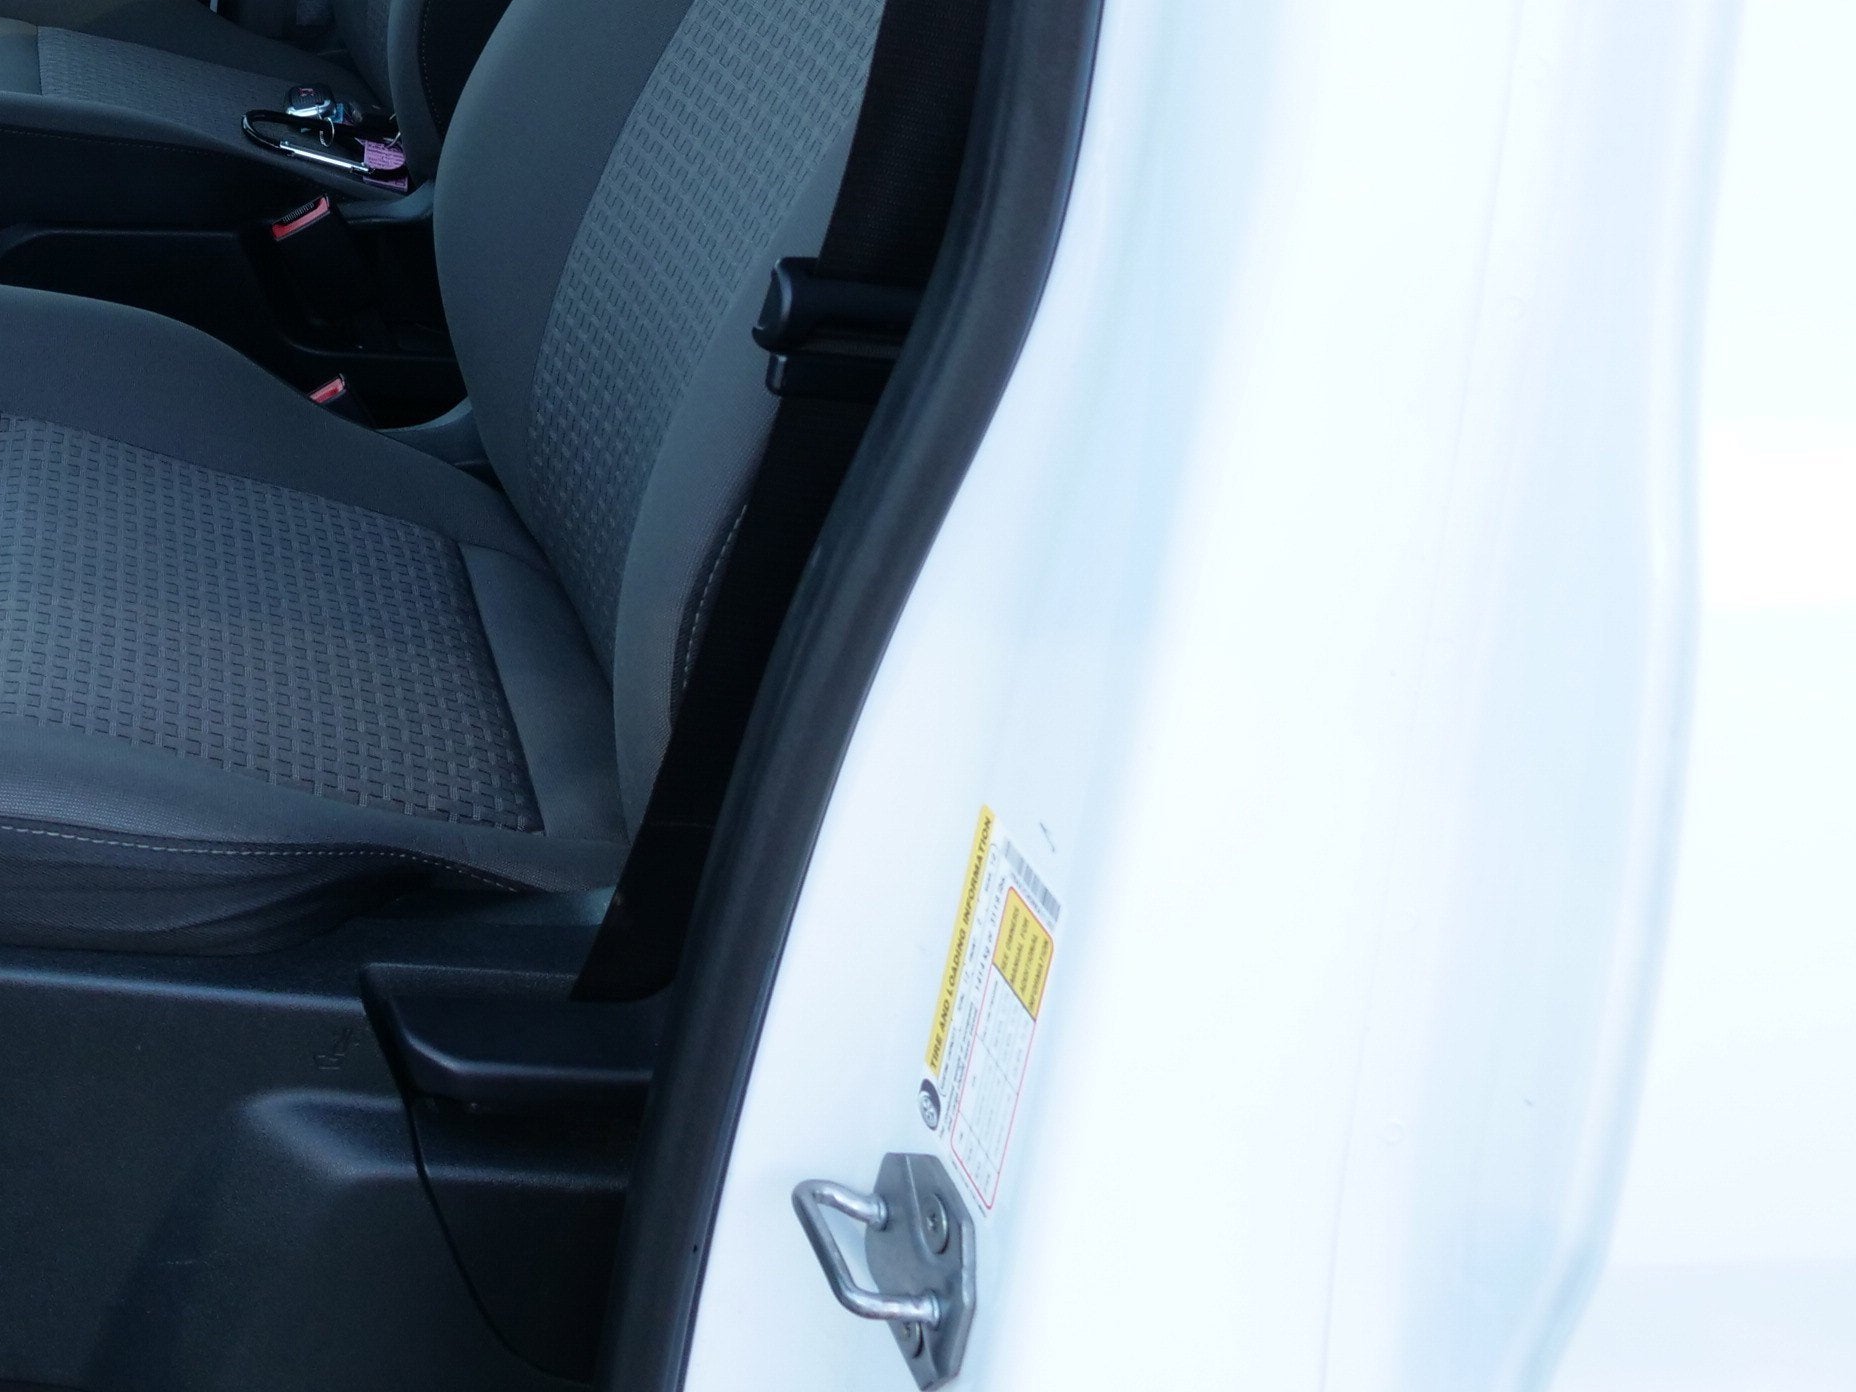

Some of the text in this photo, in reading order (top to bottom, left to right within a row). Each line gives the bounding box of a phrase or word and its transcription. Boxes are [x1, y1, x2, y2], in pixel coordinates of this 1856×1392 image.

[930, 1032, 944, 1070] TIRE
[940, 998, 952, 1029] AND
[947, 929, 968, 998] LOADING
[962, 816, 992, 925] INFORMATION
